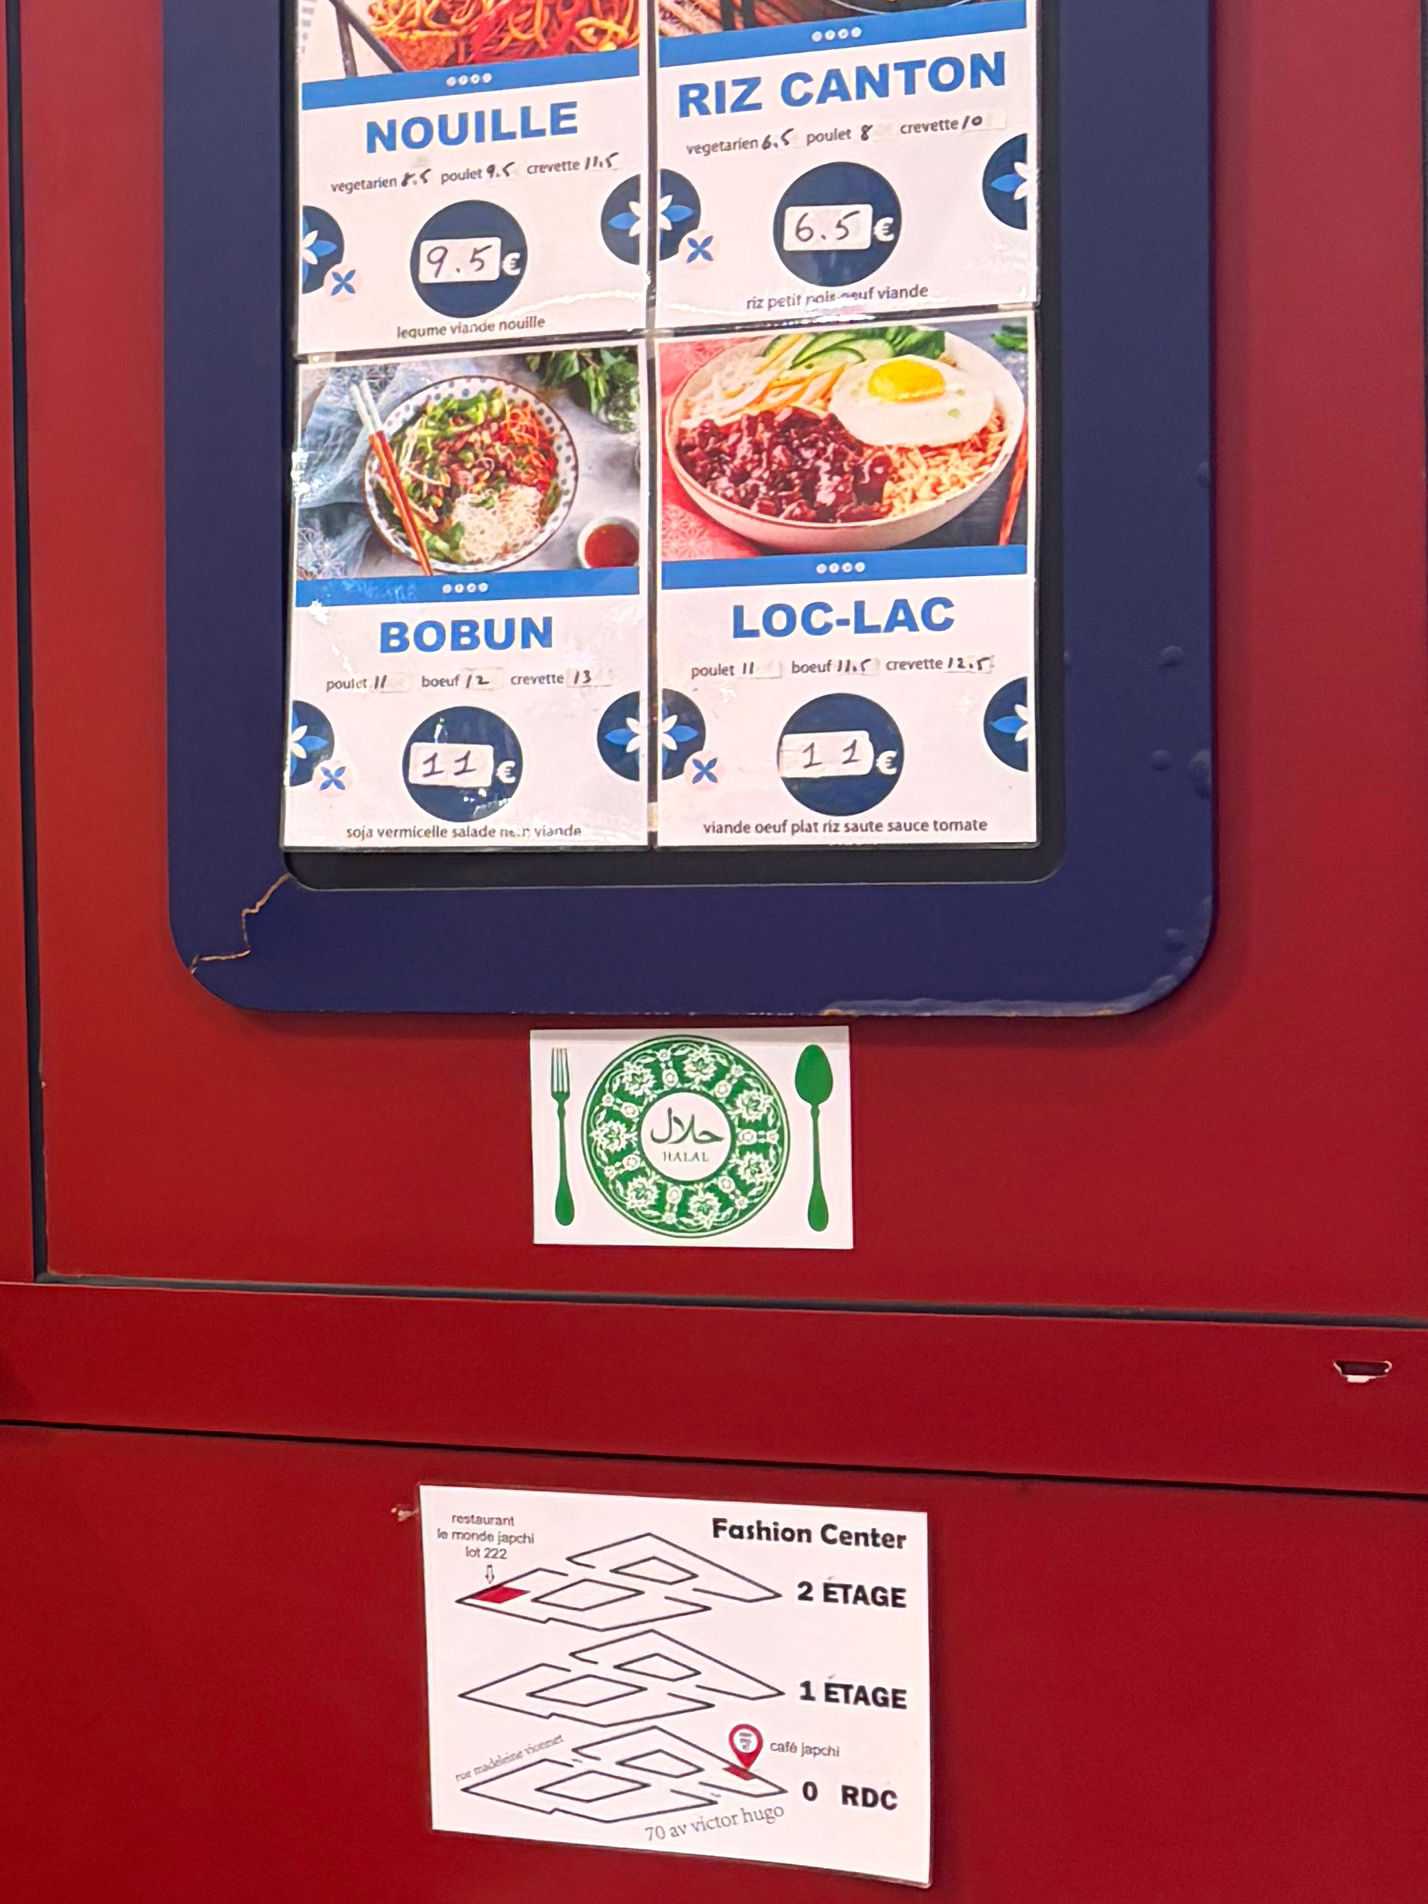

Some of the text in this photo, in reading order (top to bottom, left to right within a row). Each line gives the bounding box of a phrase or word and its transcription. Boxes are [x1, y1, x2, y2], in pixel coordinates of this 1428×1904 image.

[678, 51, 1006, 118] RIZ CANTON
[366, 100, 579, 154] NOUILLE
[686, 118, 959, 156] vegetarien poulet crevette
[331, 158, 580, 194] vegetarien poulet crevette
[795, 210, 895, 243] 6.5€
[426, 244, 521, 280] 9.5€
[877, 284, 928, 300] viande
[450, 315, 545, 335] viande nouille
[732, 596, 955, 639] LOC-LAC
[379, 616, 553, 654] BOBUN
[691, 657, 944, 680] poulet boeuf crevette
[421, 672, 565, 689] boeuf crevette
[346, 826, 374, 840] soja
[377, 825, 448, 839] vermicelle
[452, 826, 495, 839] salade
[534, 824, 582, 838] viande
[703, 818, 988, 836] viande oeuf plat saute sauce tomate
[650, 1107, 725, 1145] حلال
[662, 1151, 709, 1162] HALAL
[452, 1514, 515, 1526] restaurant
[452, 1530, 535, 1545] monde japchi
[711, 1517, 908, 1551] Fashion Center
[484, 1548, 507, 1559] 222
[796, 1581, 814, 1602] 2
[800, 1681, 816, 1702] 1
[770, 1741, 840, 1758] café japchi
[841, 1784, 898, 1811] RDC
[690, 1805, 785, 1833] victor hugo
